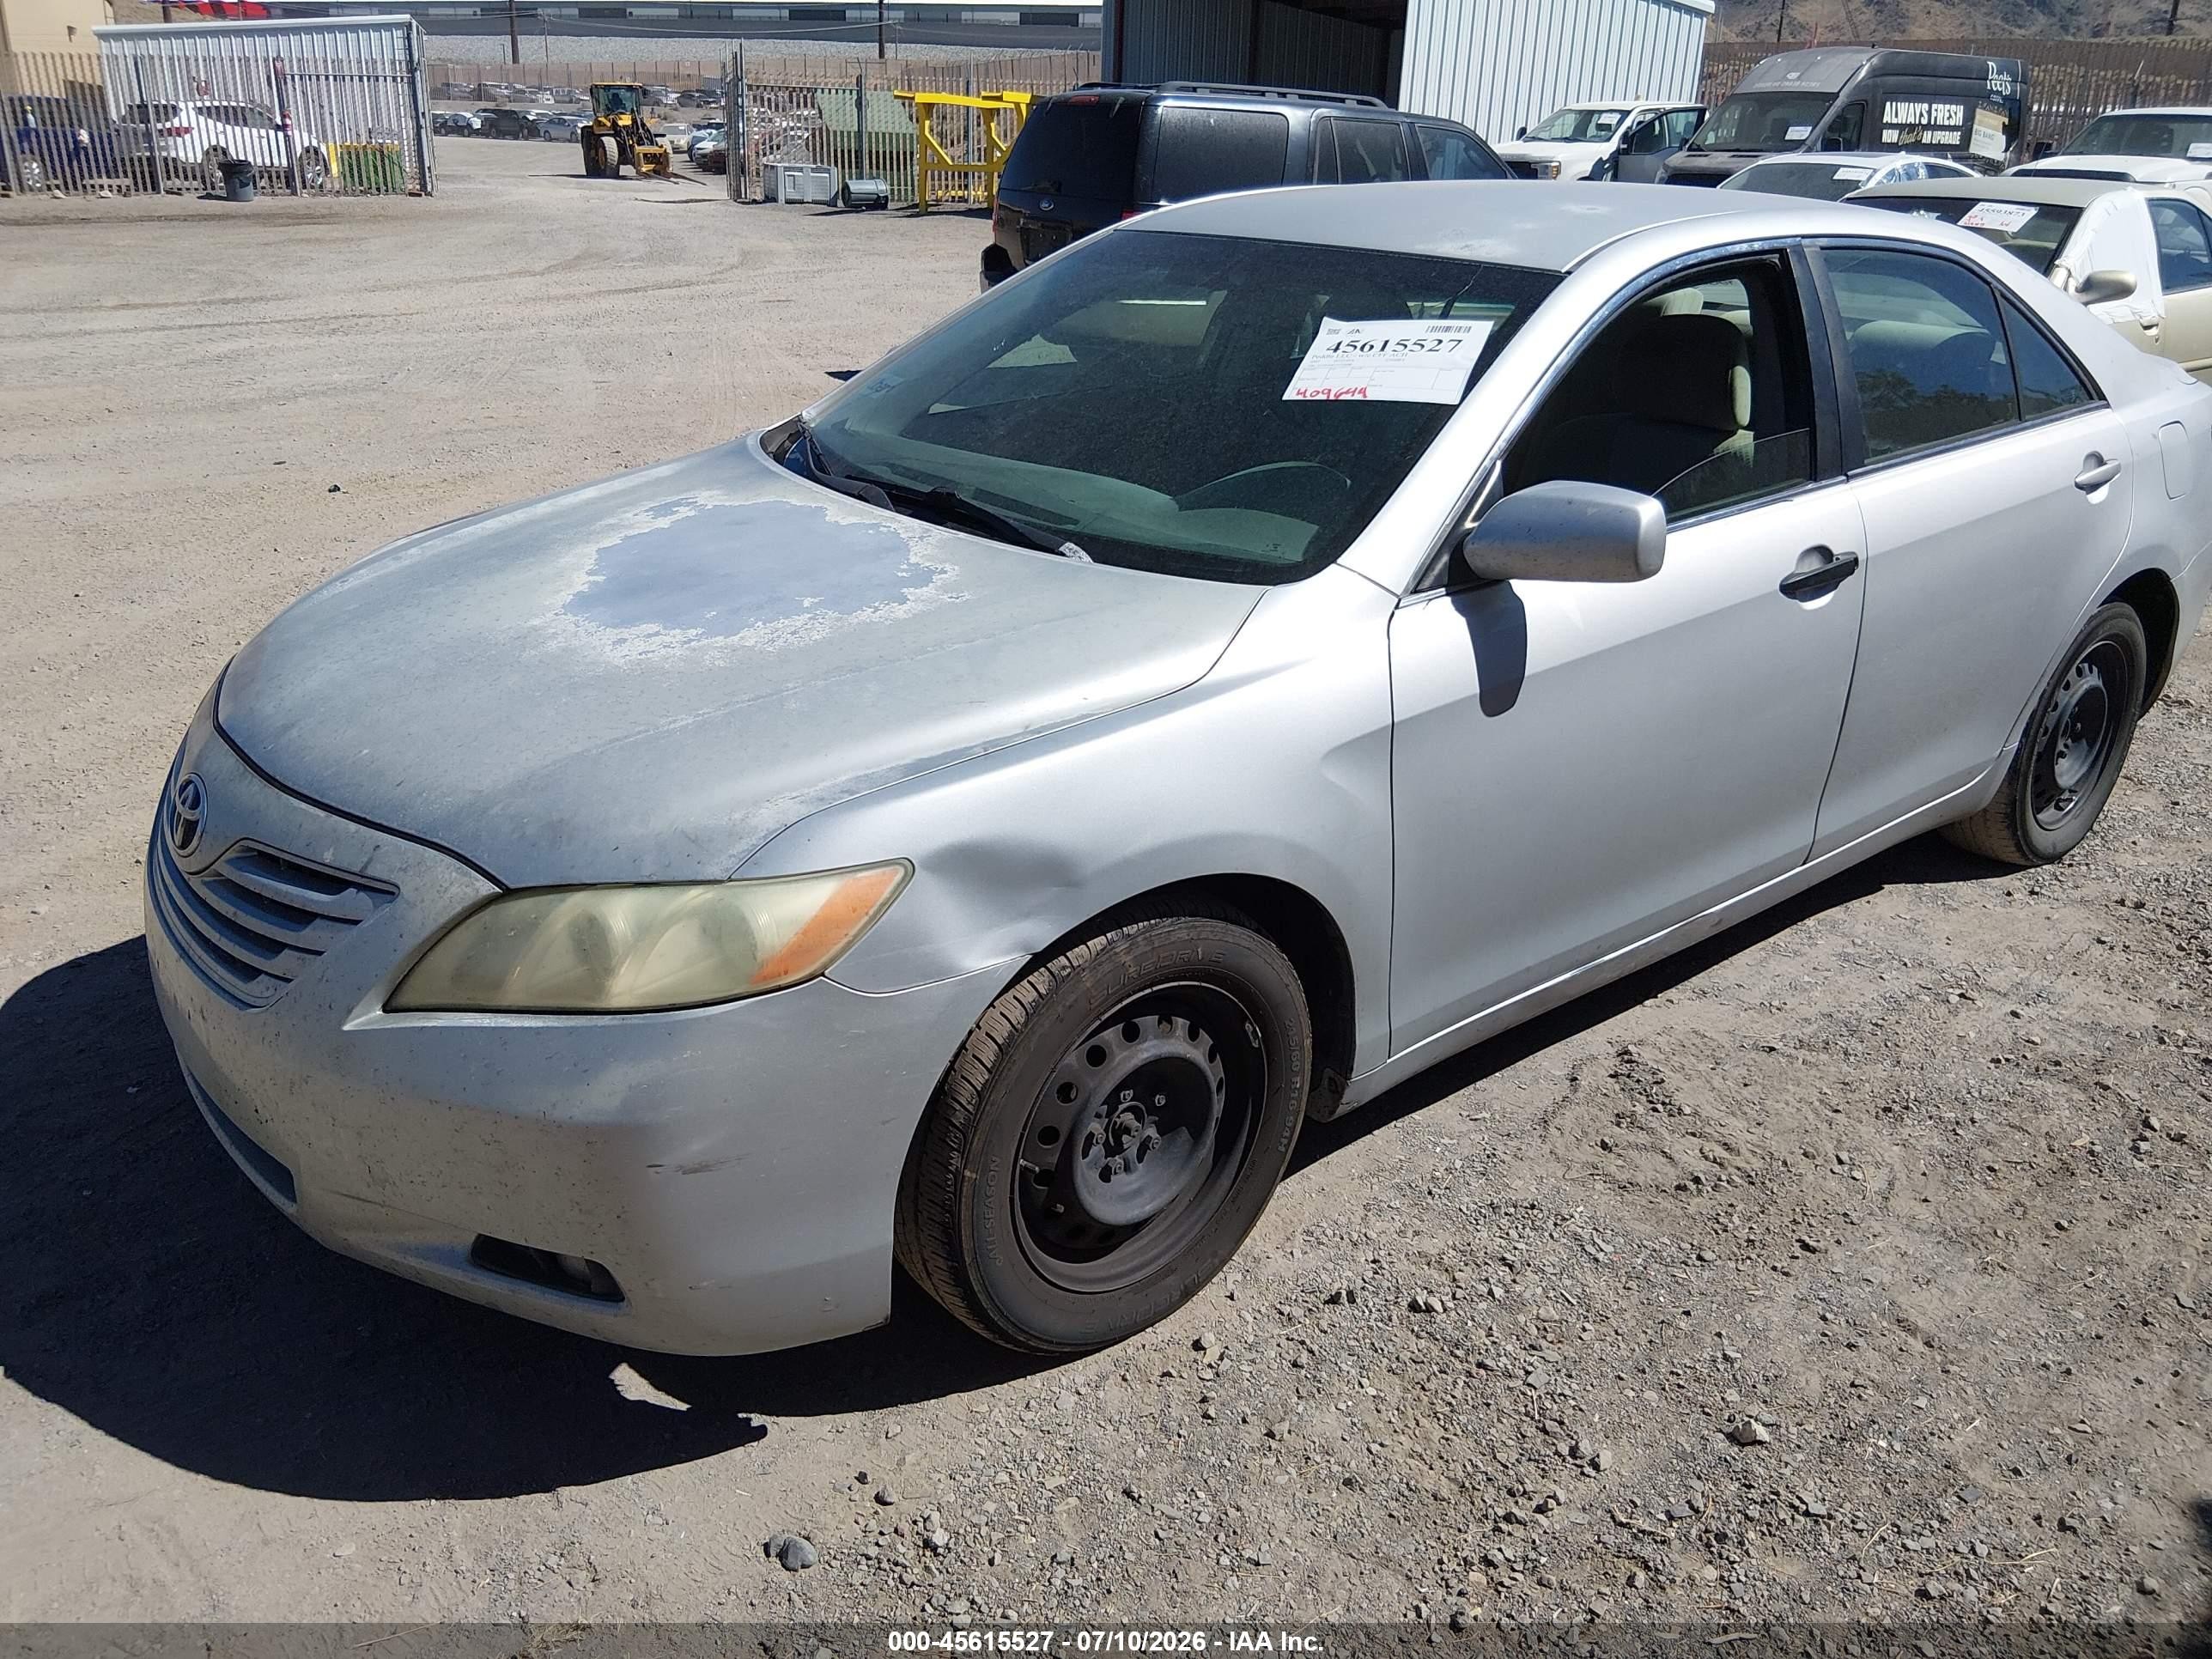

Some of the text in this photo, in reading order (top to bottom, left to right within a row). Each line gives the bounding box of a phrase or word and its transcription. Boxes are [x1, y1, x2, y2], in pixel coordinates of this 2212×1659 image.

[1882, 100, 1964, 126] ALWAYS FRESH
[1881, 129, 1899, 143] NOW
[1899, 125, 1923, 146] that's
[1922, 131, 1931, 144] AN
[1932, 131, 1961, 145] UPGRADE
[1326, 339, 1463, 354] 45615527
